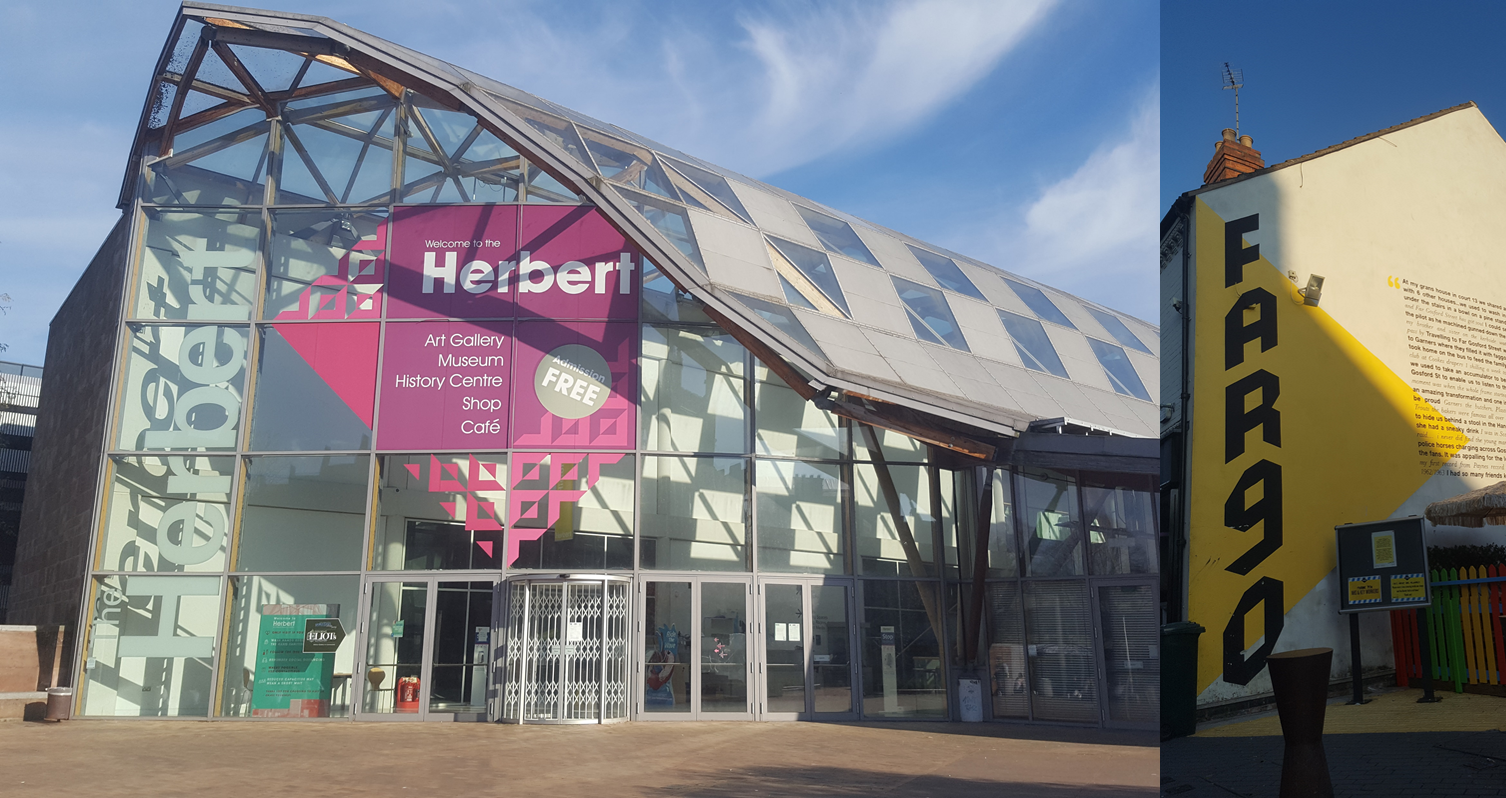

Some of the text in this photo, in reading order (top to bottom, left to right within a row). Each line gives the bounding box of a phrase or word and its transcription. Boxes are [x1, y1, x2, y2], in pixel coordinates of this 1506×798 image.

[425, 239, 501, 248] Welcome to the
[422, 250, 635, 295] Herbert
[1419, 284, 1435, 292] grans
[1436, 287, 1451, 296] house
[1404, 295, 1419, 303] under
[1443, 320, 1467, 330] machined
[424, 333, 504, 349] Art Gallery
[1426, 330, 1451, 342] Travelling
[1468, 340, 1487, 349] Gosford
[1422, 346, 1438, 354] home
[1454, 345, 1465, 353] they
[438, 353, 504, 367] Museum
[552, 355, 606, 383] Admission
[1411, 369, 1434, 378] Gosford
[1464, 371, 1493, 380] accumulator
[395, 374, 503, 390] History Centre
[541, 366, 600, 407] FREE
[1421, 389, 1445, 398] amazing
[1446, 392, 1482, 402] transformation
[462, 396, 502, 413] Shop
[461, 418, 501, 434] Café
[118, 238, 256, 658] Herbert
[1456, 444, 1479, 452] charging
